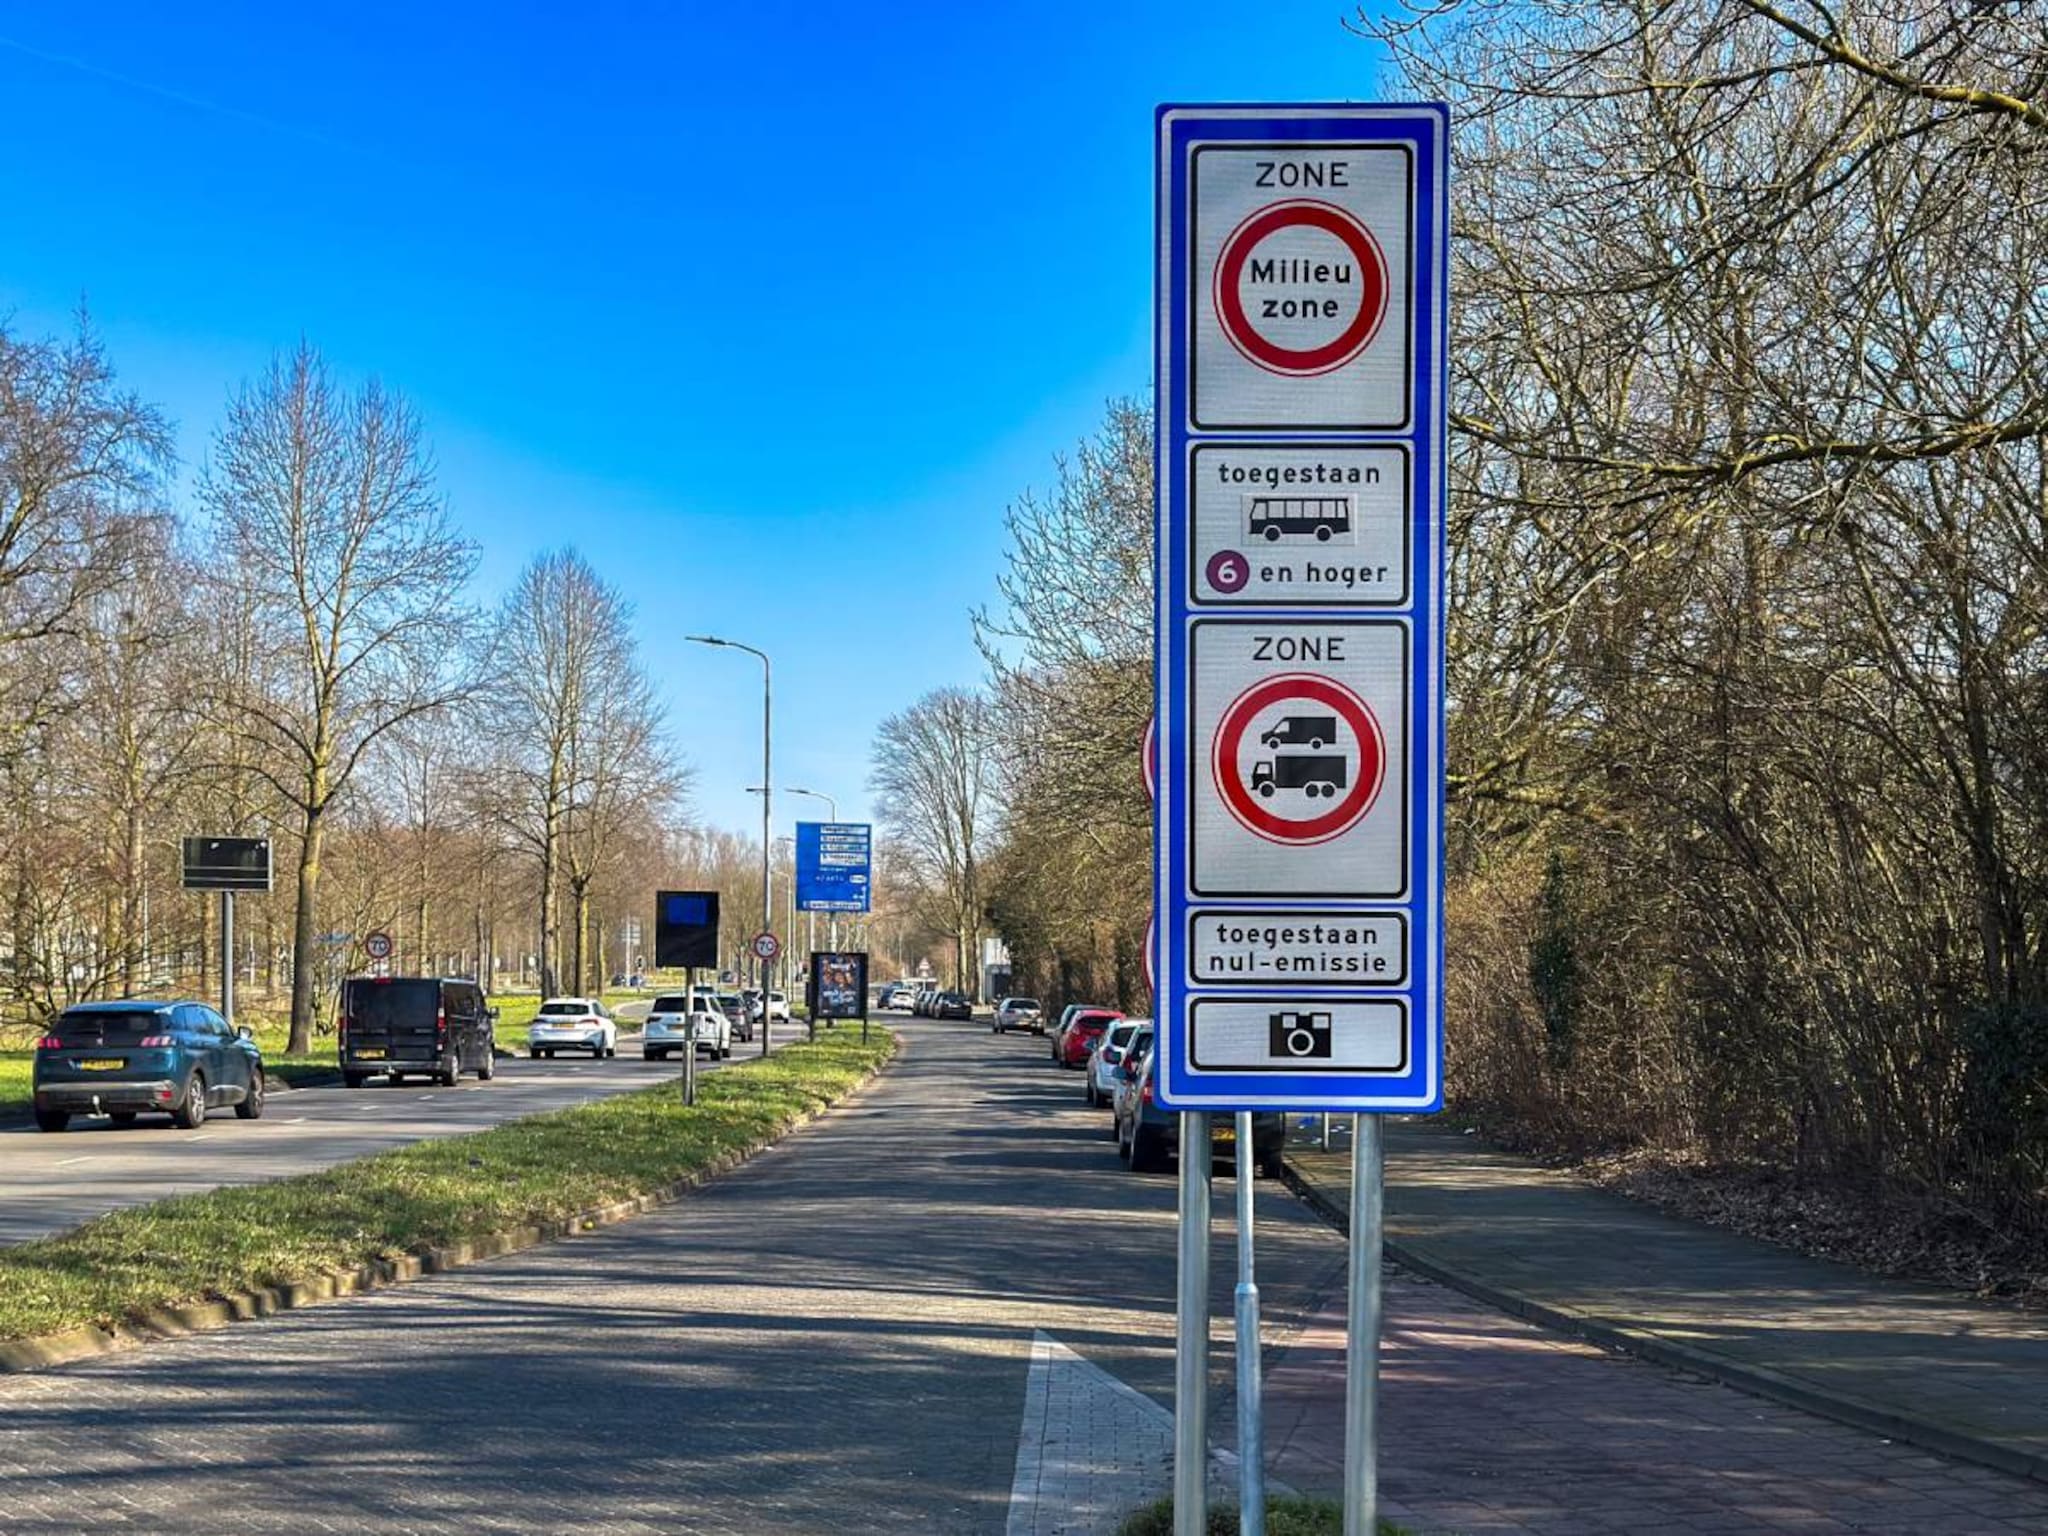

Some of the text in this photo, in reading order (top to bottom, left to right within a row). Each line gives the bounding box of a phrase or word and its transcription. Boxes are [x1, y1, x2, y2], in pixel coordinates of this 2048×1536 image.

[1255, 162, 1349, 187] ZONE
[1251, 259, 1350, 283] Milieu
[1262, 299, 1339, 318] zone
[1218, 463, 1380, 489] toegestaan
[1217, 560, 1388, 589] 6 en hoger
[1253, 637, 1346, 661] ZONE
[371, 940, 387, 952] 70
[758, 940, 775, 952] 70
[1217, 923, 1378, 949] toegestaan
[1209, 951, 1387, 972] nul-emissie
